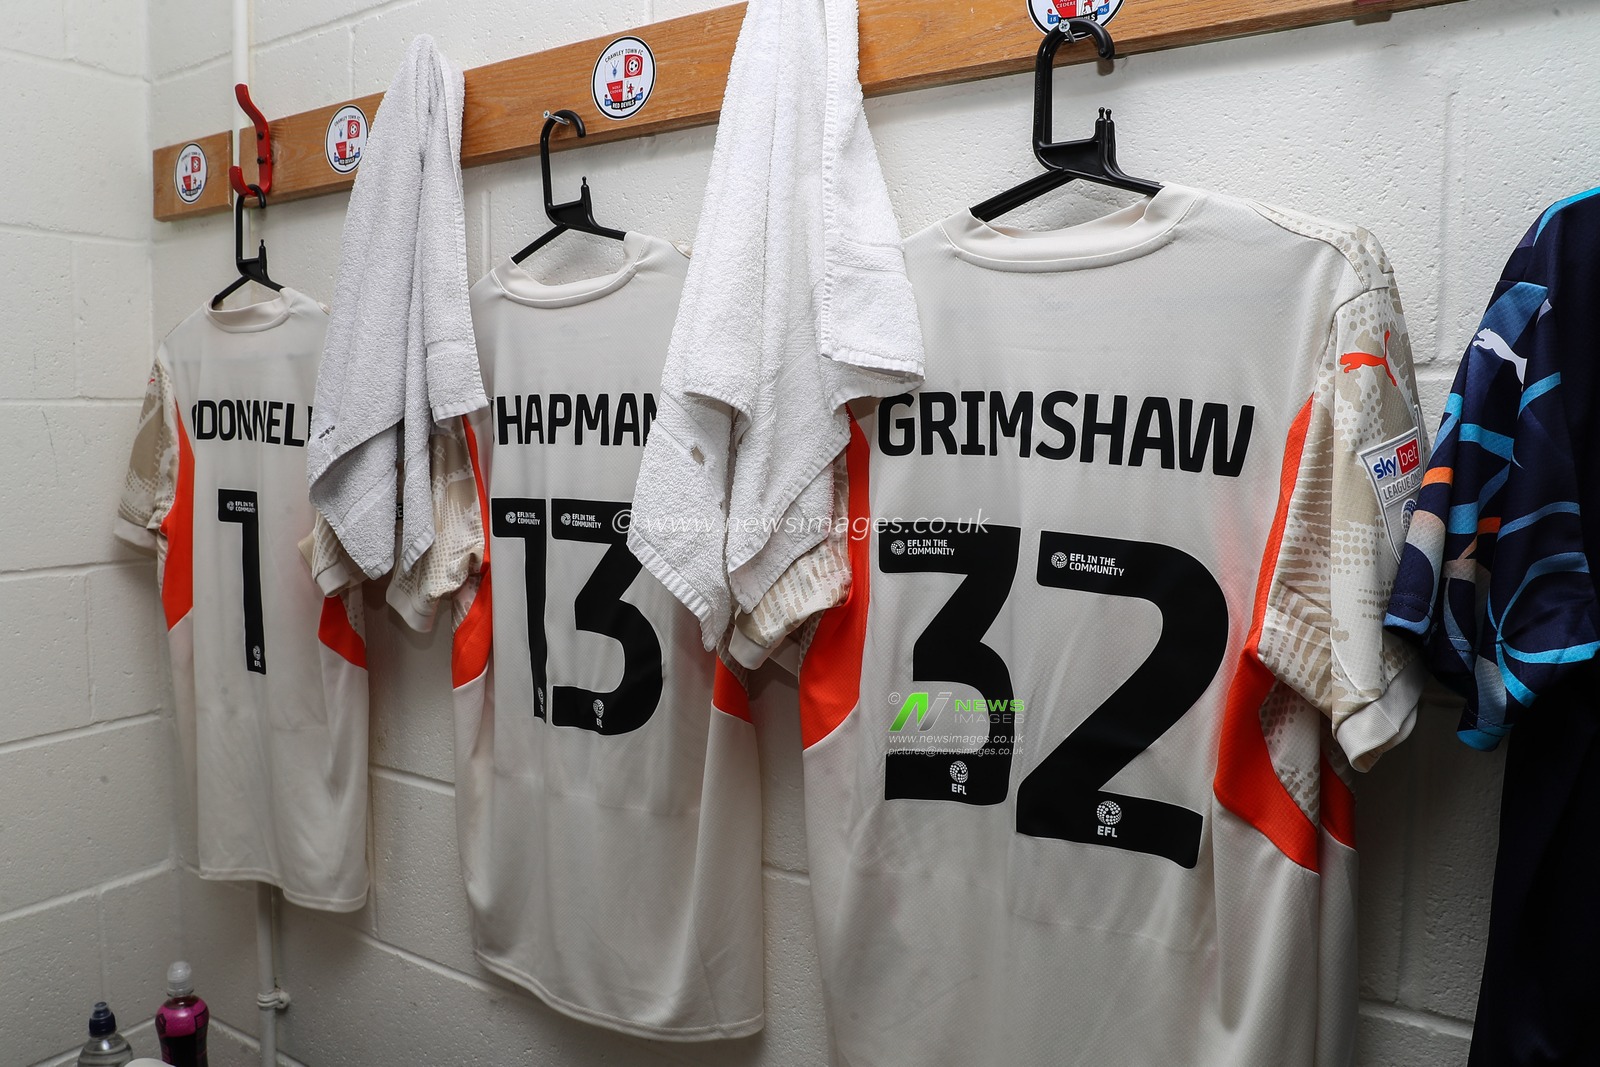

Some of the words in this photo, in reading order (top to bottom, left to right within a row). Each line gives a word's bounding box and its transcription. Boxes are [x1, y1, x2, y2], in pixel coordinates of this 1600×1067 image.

[605, 49, 624, 63] CRAWLEY
[191, 399, 313, 447] DONNEL
[491, 393, 659, 447] HAPMA
[878, 390, 1256, 478] GRIMSHAW
[1373, 455, 1397, 480] sky
[1399, 445, 1418, 467] bet
[1382, 475, 1411, 500] LEAGUE
[571, 520, 602, 529] COMMUNITY
[586, 514, 596, 522] THE
[907, 539, 921, 547] EFL
[922, 539, 932, 547] IN
[933, 539, 948, 547] THE
[907, 547, 955, 556] COMMUNITY
[1069, 552, 1086, 563] EFL
[1087, 554, 1098, 564] IN
[1099, 556, 1116, 567] THE
[1069, 561, 1125, 577] COMMUNITY
[217, 488, 267, 675] 1
[490, 497, 664, 736] 13
[878, 521, 1230, 870] 32
[951, 783, 968, 796] EFL
[1097, 825, 1119, 838] EFL
